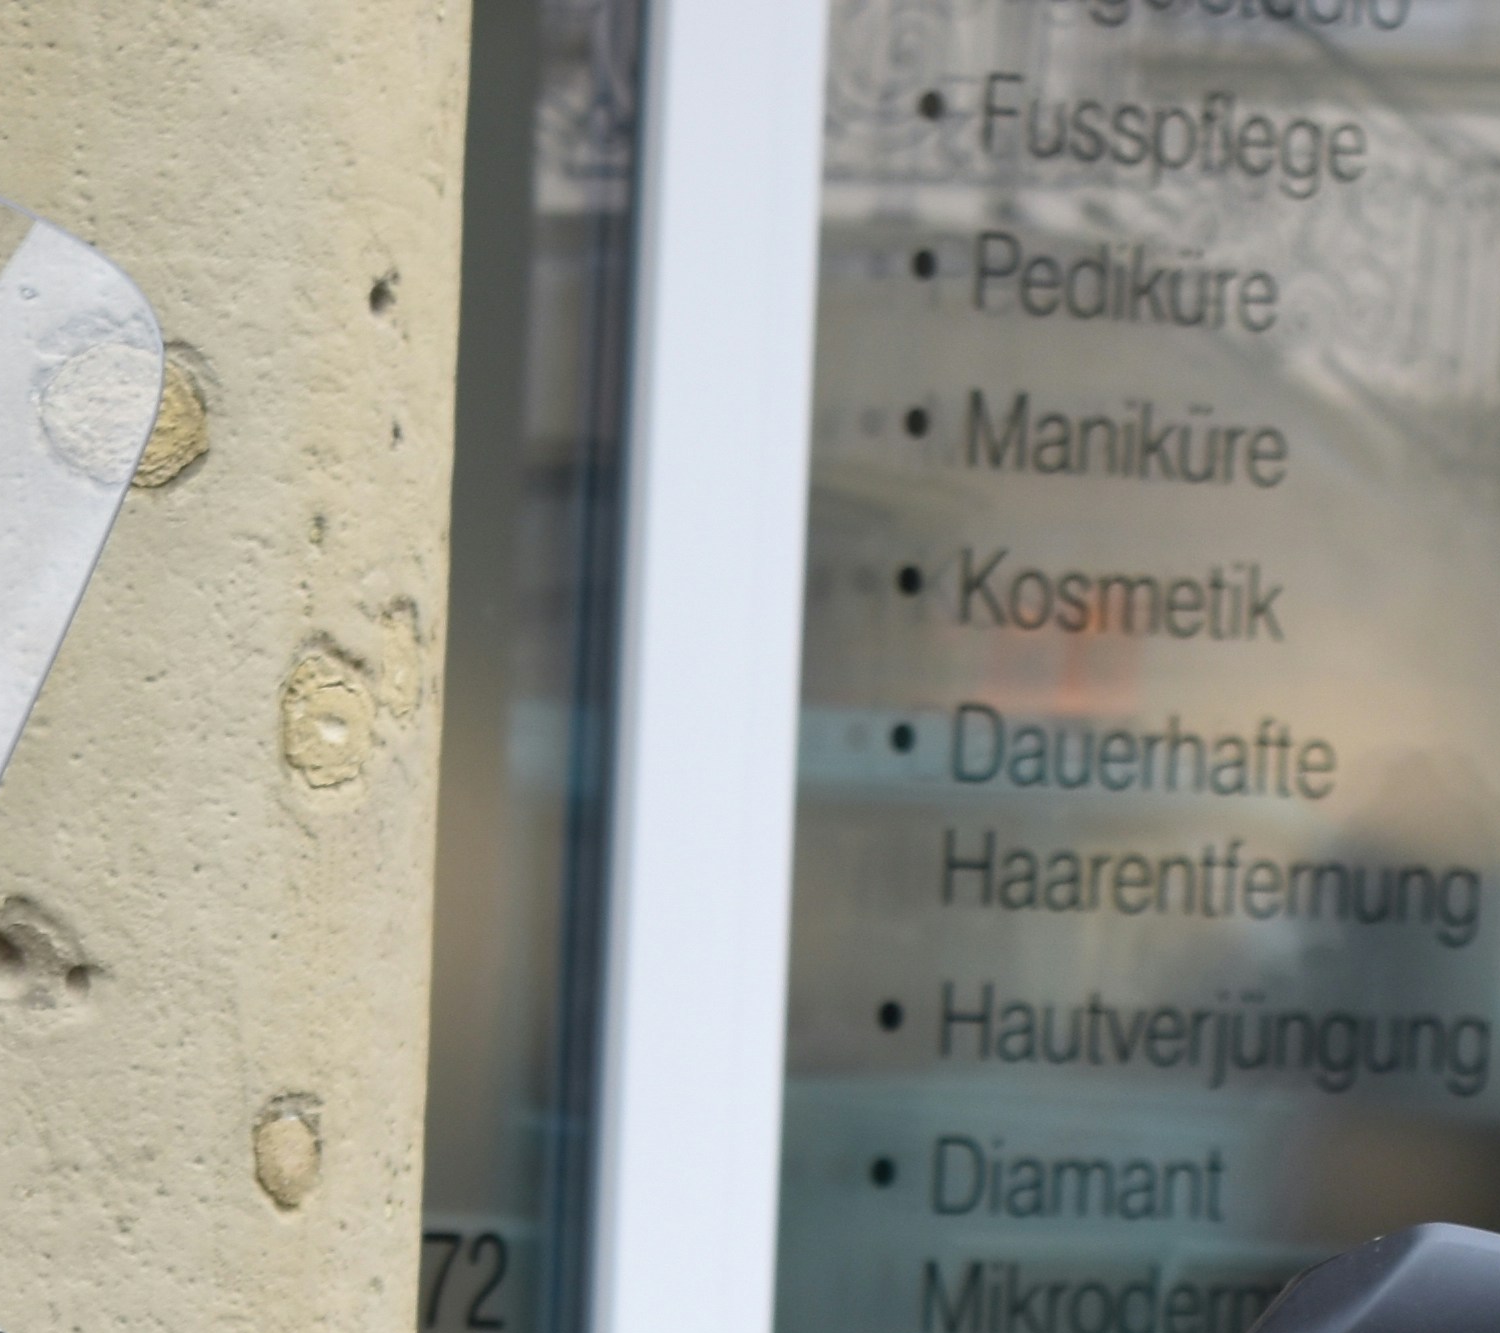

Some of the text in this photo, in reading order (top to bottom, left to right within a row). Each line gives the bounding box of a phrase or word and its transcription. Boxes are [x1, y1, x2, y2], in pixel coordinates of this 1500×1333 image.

[980, 71, 1368, 200] Fusspflege
[973, 230, 1281, 332] Pediküre
[964, 388, 1290, 489] Maniküre
[957, 546, 1285, 642] Kosmetik
[951, 702, 1339, 800] Dauerhafte
[940, 828, 1483, 948] Haarentfernung
[938, 979, 1492, 1098] Hautverjüngung
[930, 1132, 1225, 1222] Diamant
[422, 1231, 507, 1330] 72
